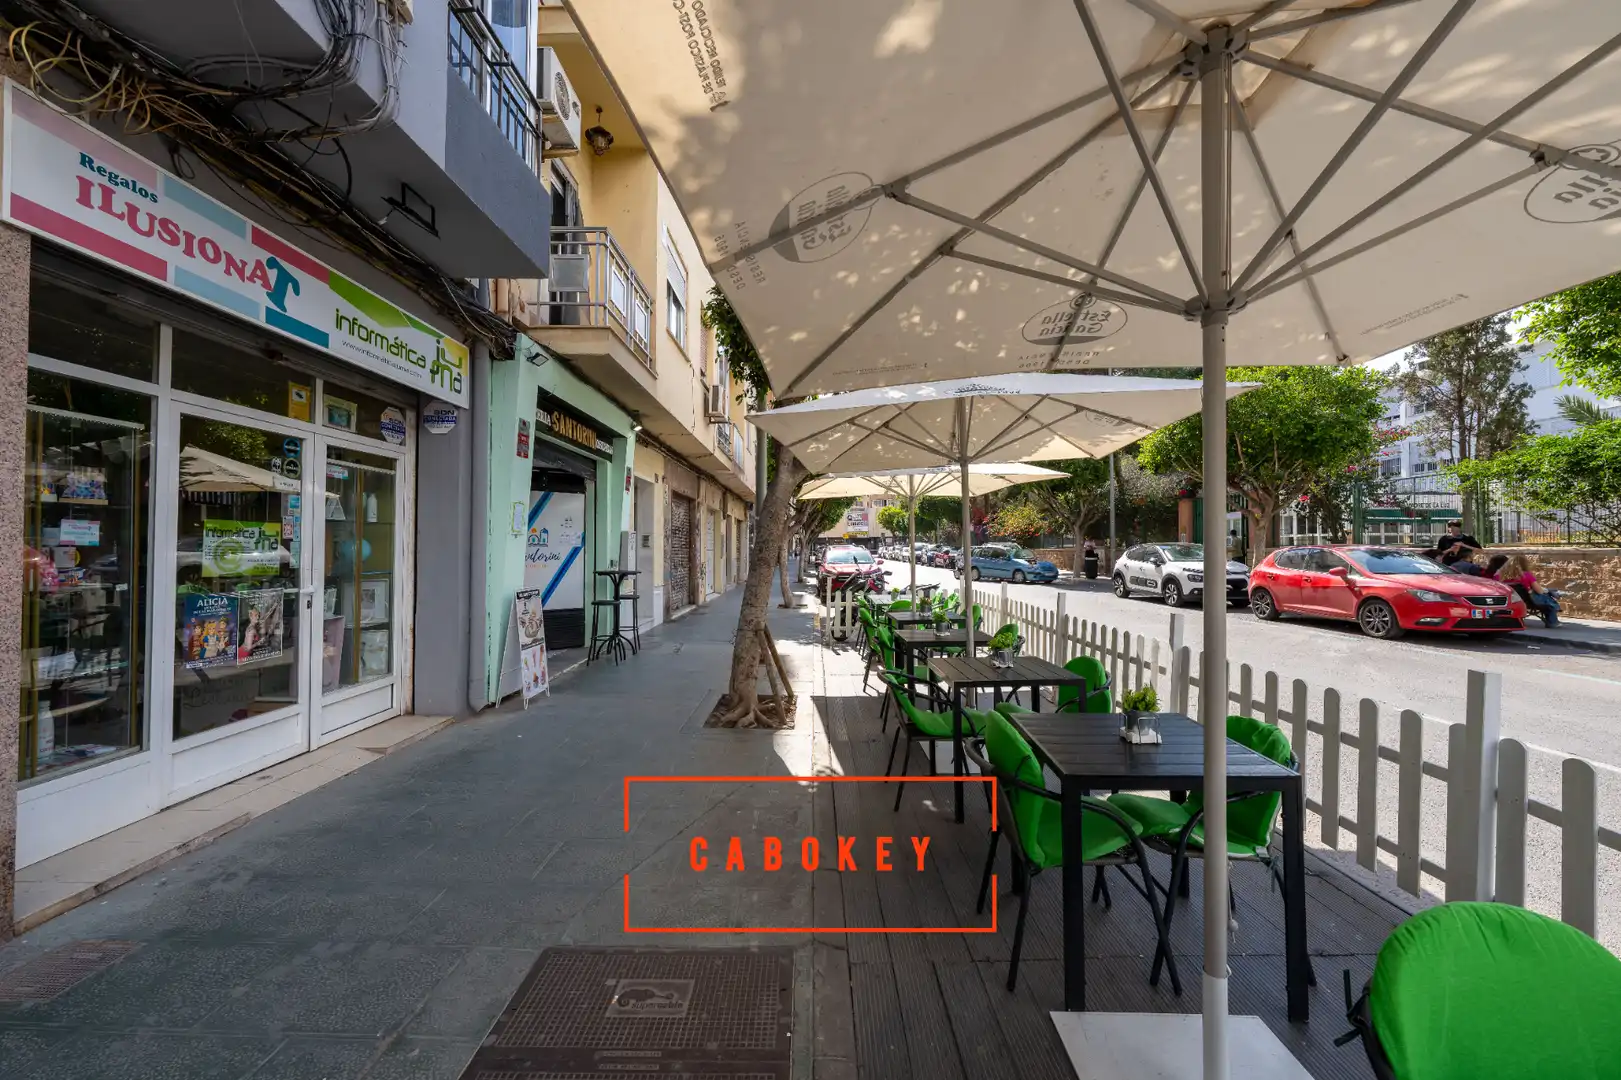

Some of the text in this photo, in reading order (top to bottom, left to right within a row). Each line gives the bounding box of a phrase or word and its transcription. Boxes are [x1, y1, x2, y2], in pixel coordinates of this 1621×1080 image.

[79, 151, 159, 203] Regalos
[335, 308, 427, 370] informática
[552, 411, 597, 450] SANTORINI
[197, 597, 229, 607] ALICIA
